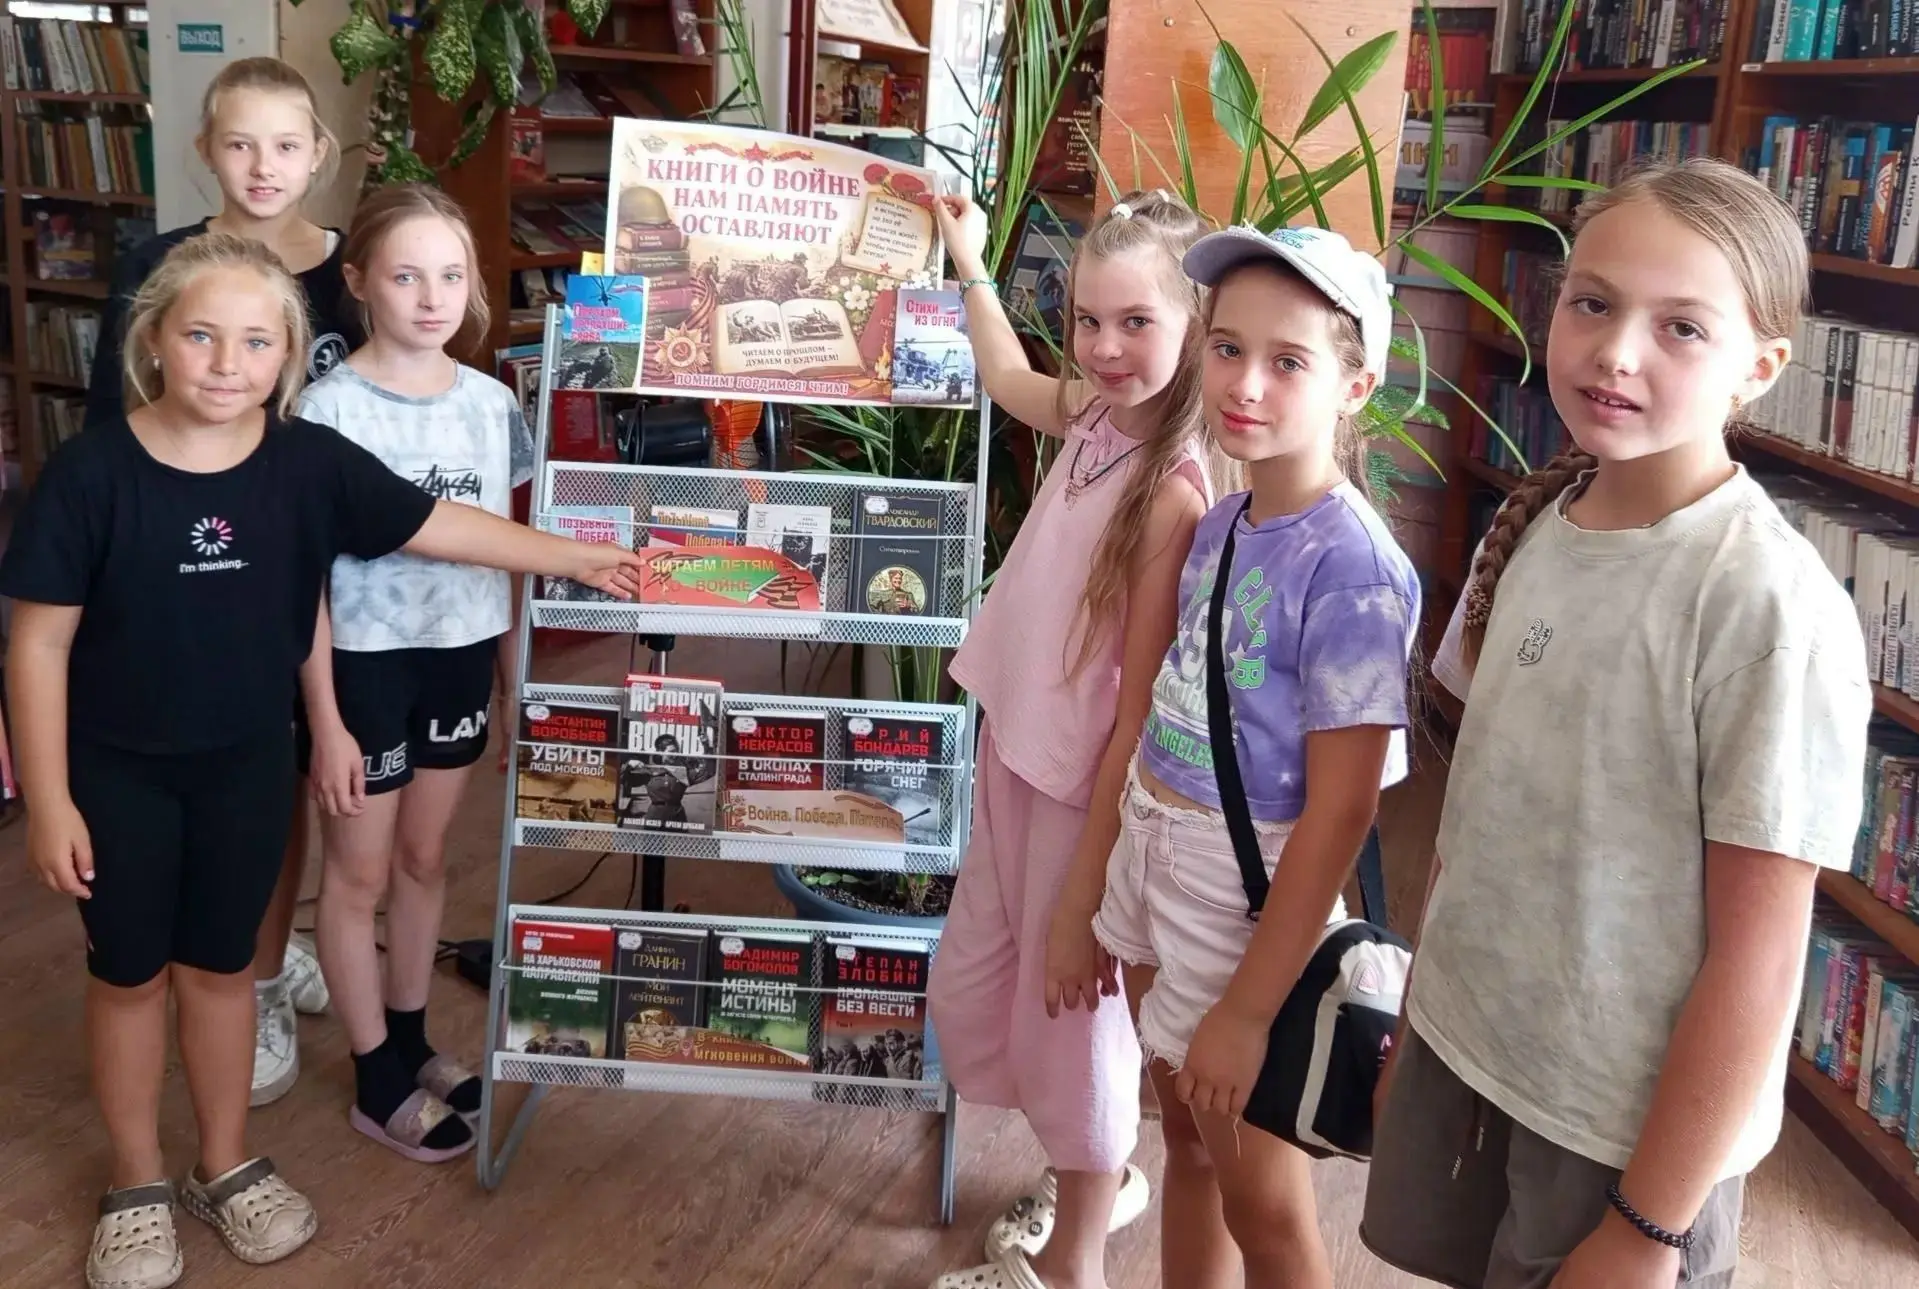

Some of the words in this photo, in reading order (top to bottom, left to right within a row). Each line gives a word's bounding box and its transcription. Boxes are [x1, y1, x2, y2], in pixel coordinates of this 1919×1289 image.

[180, 29, 221, 48] ВЫХОД
[647, 158, 737, 185] КНИГИ
[747, 167, 764, 188] О
[774, 168, 860, 197] ВОЙНЕ
[674, 188, 726, 209] НАМ
[737, 193, 838, 221] ПАМЯТЬ
[682, 214, 832, 244] ОСТАВЛЯЮТ
[742, 348, 774, 357] ЧИТАЕМ
[784, 346, 825, 355] ПРОШЛОМ
[745, 358, 781, 367] ДУМАЕМ
[793, 354, 839, 364] БУДУЩЕМ!
[674, 373, 734, 388] ПОМНИМ!
[736, 376, 807, 393] ГОРДИМСЯ!
[809, 381, 849, 395] ЧТИМ!
[865, 514, 936, 529] ТВАРДОВСКИЙ
[179, 563, 196, 574] I'm
[650, 559, 716, 573] ЧИТАЕМ
[696, 577, 750, 593] ВОЙНЕ
[531, 726, 606, 743] ВОРОБЬЕВ
[739, 726, 814, 740] ИКТОР
[856, 729, 929, 743] РИЙ
[739, 738, 814, 753] НЕКРАСОВ
[854, 741, 928, 757] БОНДАРЕВ
[531, 745, 605, 766] УБИТЫ
[530, 762, 552, 773] ПОД
[554, 763, 605, 777] МОСКВОЙ
[739, 760, 748, 770] В
[752, 760, 812, 773] ОКОПАХ
[854, 758, 927, 776] ГОРЯЧИЙ
[738, 772, 812, 784] СТАЛИНГРАДА
[891, 775, 926, 789] СНЕГ
[748, 805, 791, 821] Война.
[523, 953, 535, 963] НА
[537, 954, 601, 970] ХАРЬКОВСКОМ
[632, 953, 686, 971] ГРАНИН
[725, 948, 800, 962] АДИМИР
[723, 959, 799, 976] БОГОМОЛОВ
[838, 968, 917, 985] ЗЛОБИН
[722, 977, 798, 998] МОМЕНТ
[837, 986, 915, 1003] ПРОПАВШИЕ
[721, 993, 796, 1014] ИСТИНЫ
[836, 999, 864, 1014] БЕЗ
[868, 1002, 916, 1018] ВЕСТИ
[769, 1054, 806, 1067] войн
